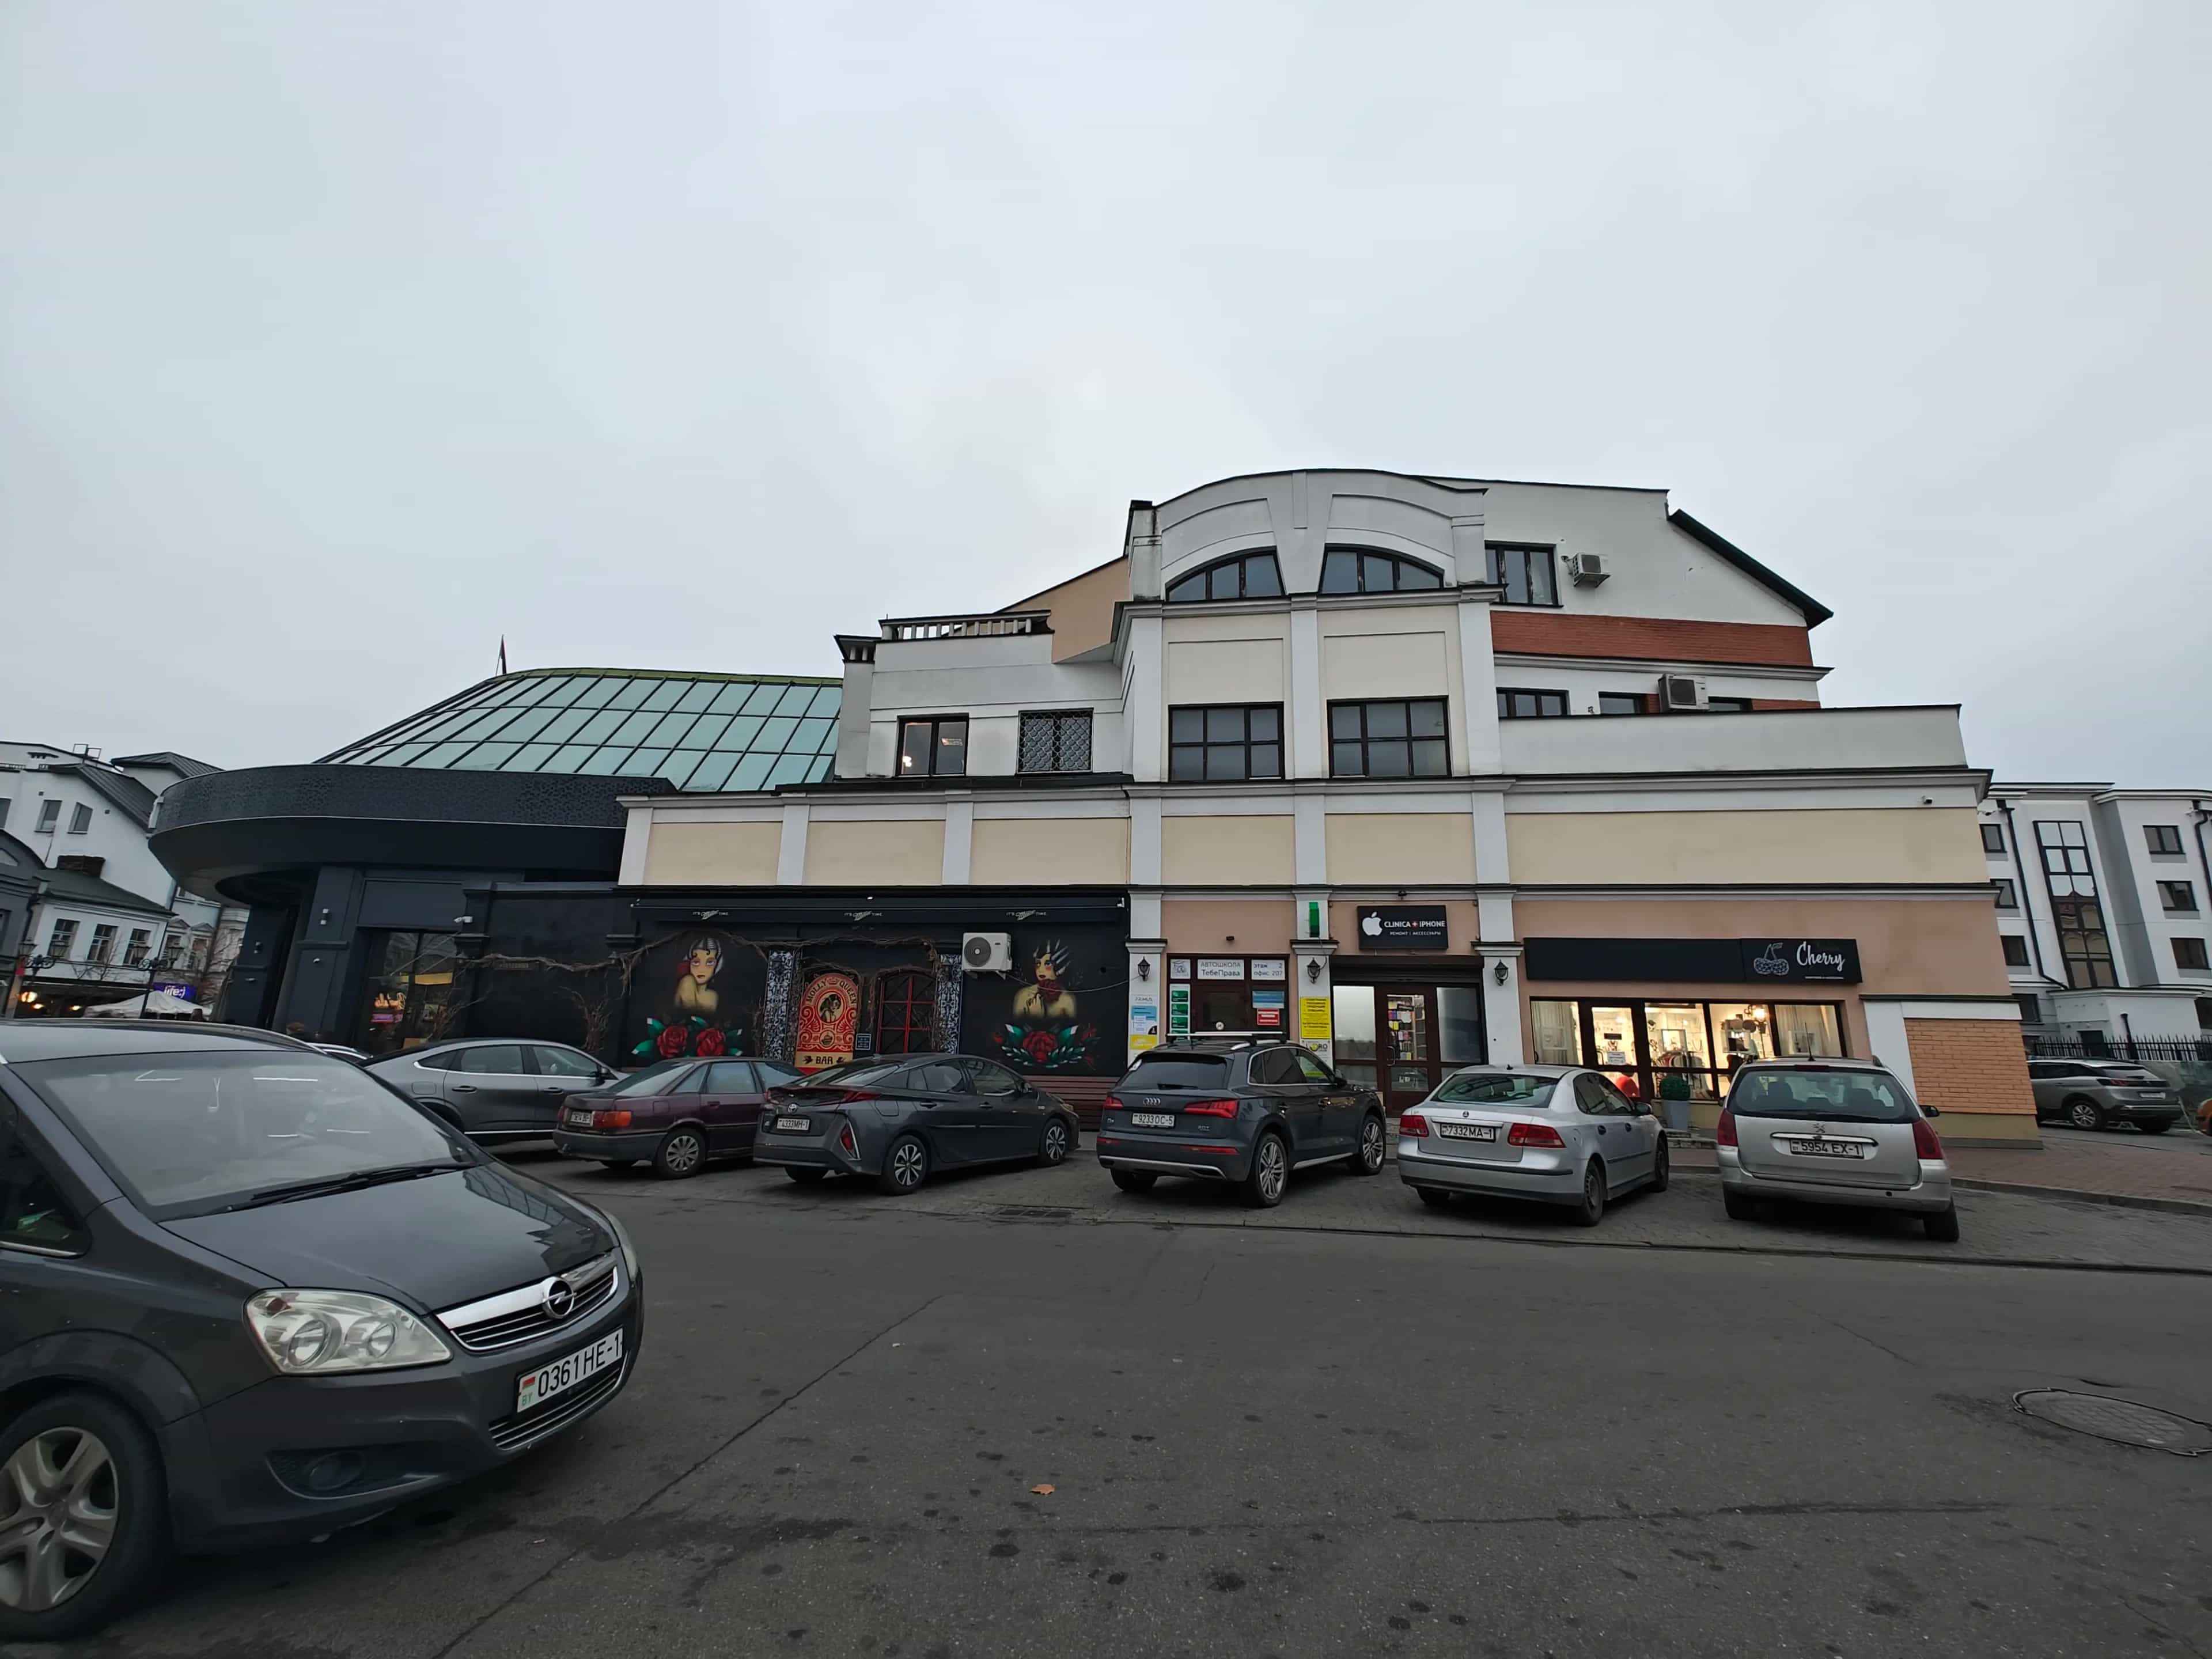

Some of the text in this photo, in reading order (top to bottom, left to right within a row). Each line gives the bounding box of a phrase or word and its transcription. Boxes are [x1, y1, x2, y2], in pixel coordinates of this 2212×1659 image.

[1797, 941, 1846, 972] Cherry
[1201, 969, 1240, 977] ТебеПрава
[806, 979, 857, 1005] MOLLY QUEEN
[816, 1056, 834, 1065] BAR
[522, 1392, 533, 1406] BY
